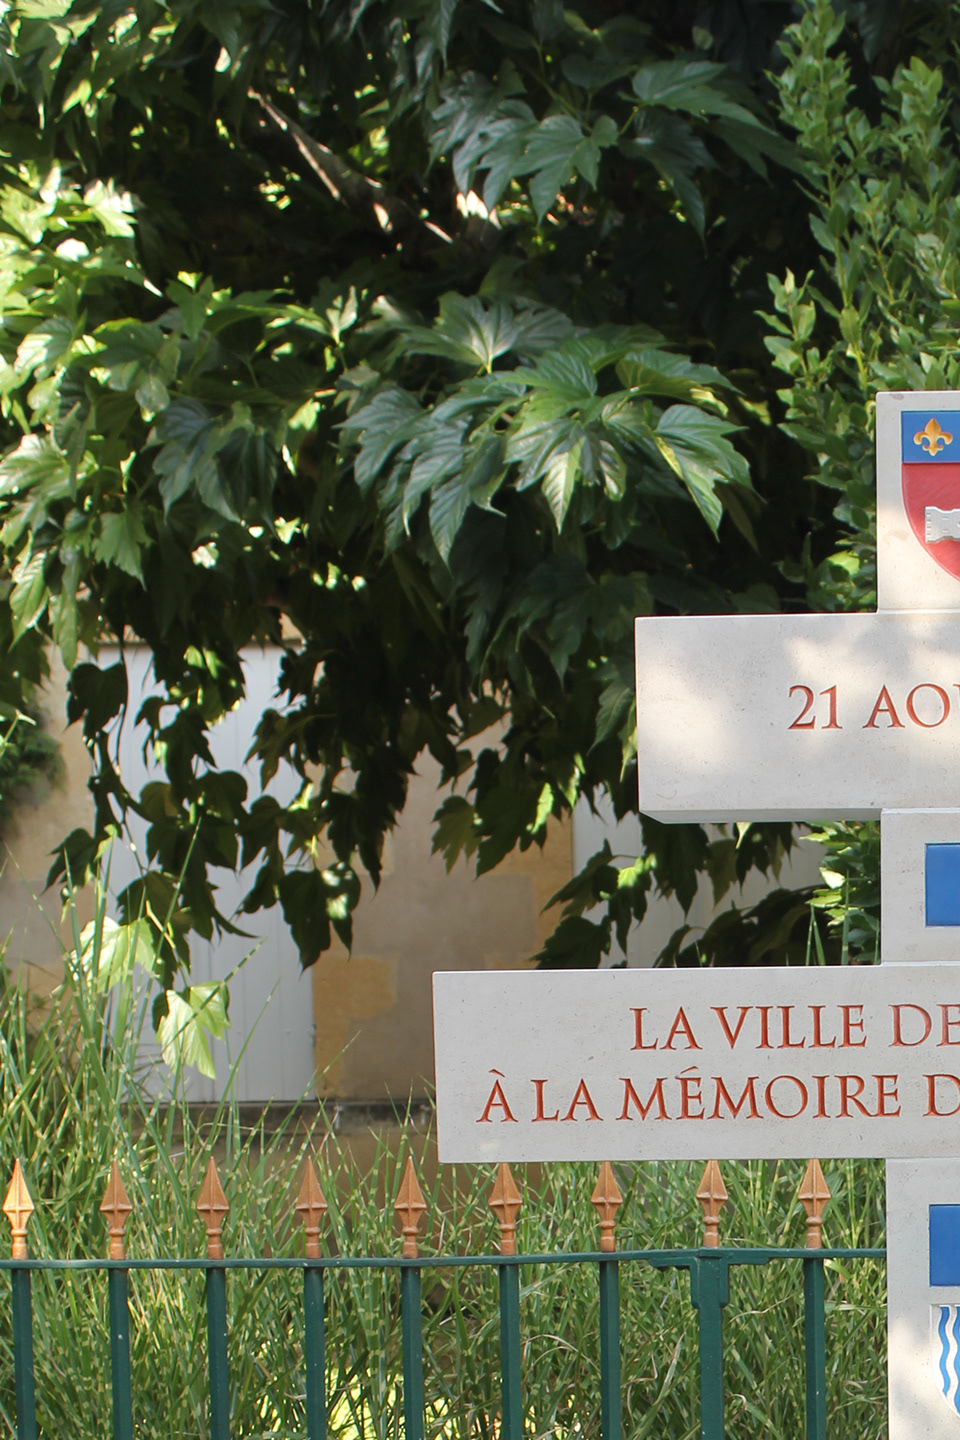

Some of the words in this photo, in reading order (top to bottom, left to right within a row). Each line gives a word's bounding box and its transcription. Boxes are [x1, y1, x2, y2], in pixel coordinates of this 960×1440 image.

[789, 684, 841, 731] 21
[630, 1006, 703, 1051] LA
[711, 1004, 867, 1050] VILLE
[477, 1068, 518, 1123] À
[532, 1078, 603, 1122] LA
[617, 1065, 902, 1120] MÉMOIRE
